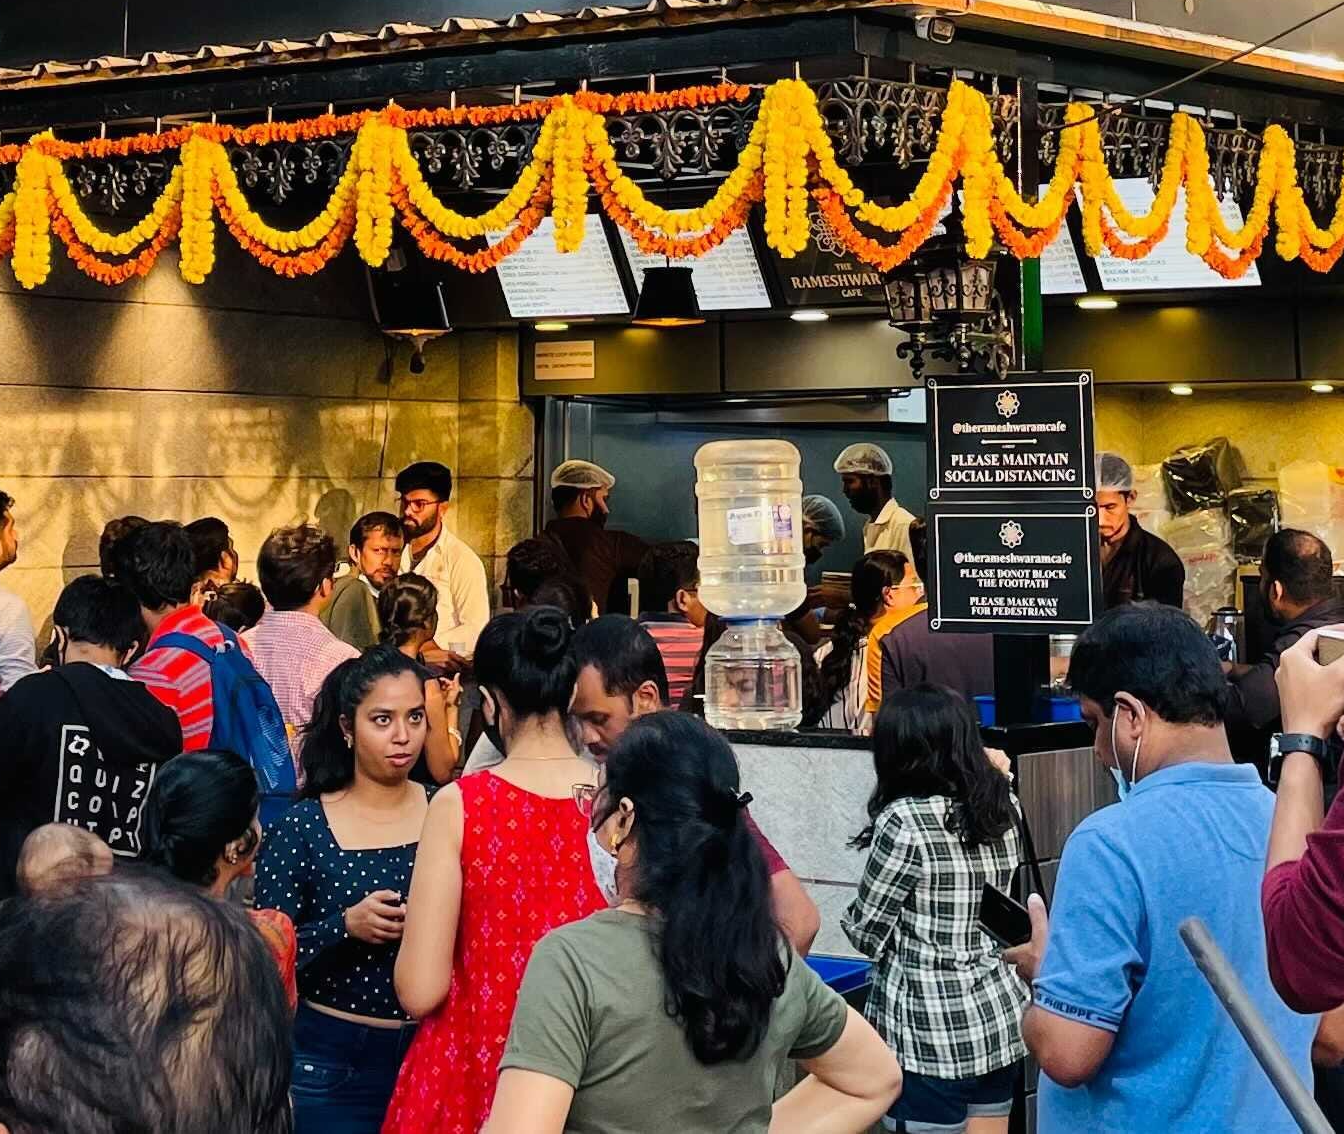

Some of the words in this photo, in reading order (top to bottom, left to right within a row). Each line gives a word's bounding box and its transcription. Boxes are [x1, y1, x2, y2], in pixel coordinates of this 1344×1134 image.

[834, 263, 853, 271] THE
[790, 272, 883, 289] RAMESHWAR
[841, 288, 863, 297] CAFE
[952, 422, 1067, 434] @therameshwaramcafe
[951, 453, 1000, 467] PLEASE
[1002, 452, 1069, 466] MAINTAIN
[944, 469, 993, 482] SOCIAL
[995, 469, 1076, 482] DISTANCING
[954, 552, 1072, 564] @therameshwaramcafe
[960, 569, 996, 579] PLEASE
[997, 569, 1031, 579] DONOT
[1032, 569, 1067, 579] BLOCK
[977, 579, 998, 588] THE
[998, 579, 1049, 589] FOOTPATH
[970, 597, 1006, 606] PLEASE
[1006, 597, 1035, 606] MAKE
[1036, 597, 1059, 607] WAY
[971, 606, 991, 616] FOR
[992, 606, 1058, 617] PEDESTRIANS
